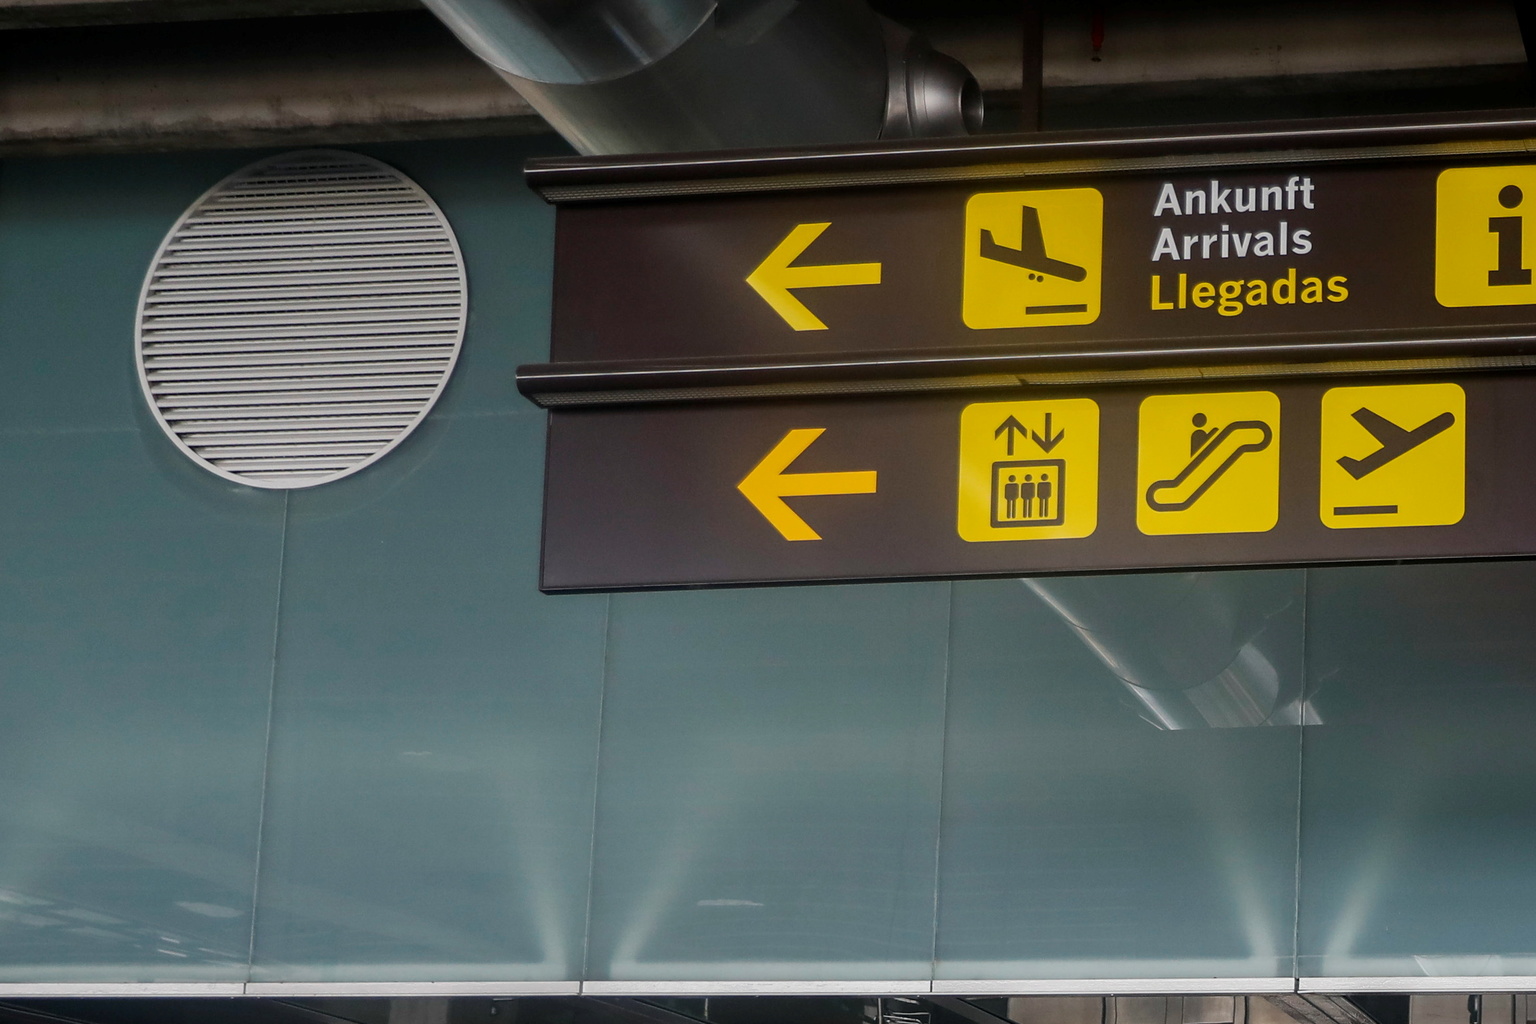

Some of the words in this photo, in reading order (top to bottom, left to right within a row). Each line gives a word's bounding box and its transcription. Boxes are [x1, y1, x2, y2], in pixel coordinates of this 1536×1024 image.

[1152, 176, 1316, 218] Ankunft
[1151, 221, 1312, 262] Arrivals
[1149, 268, 1350, 317] Llegadas
